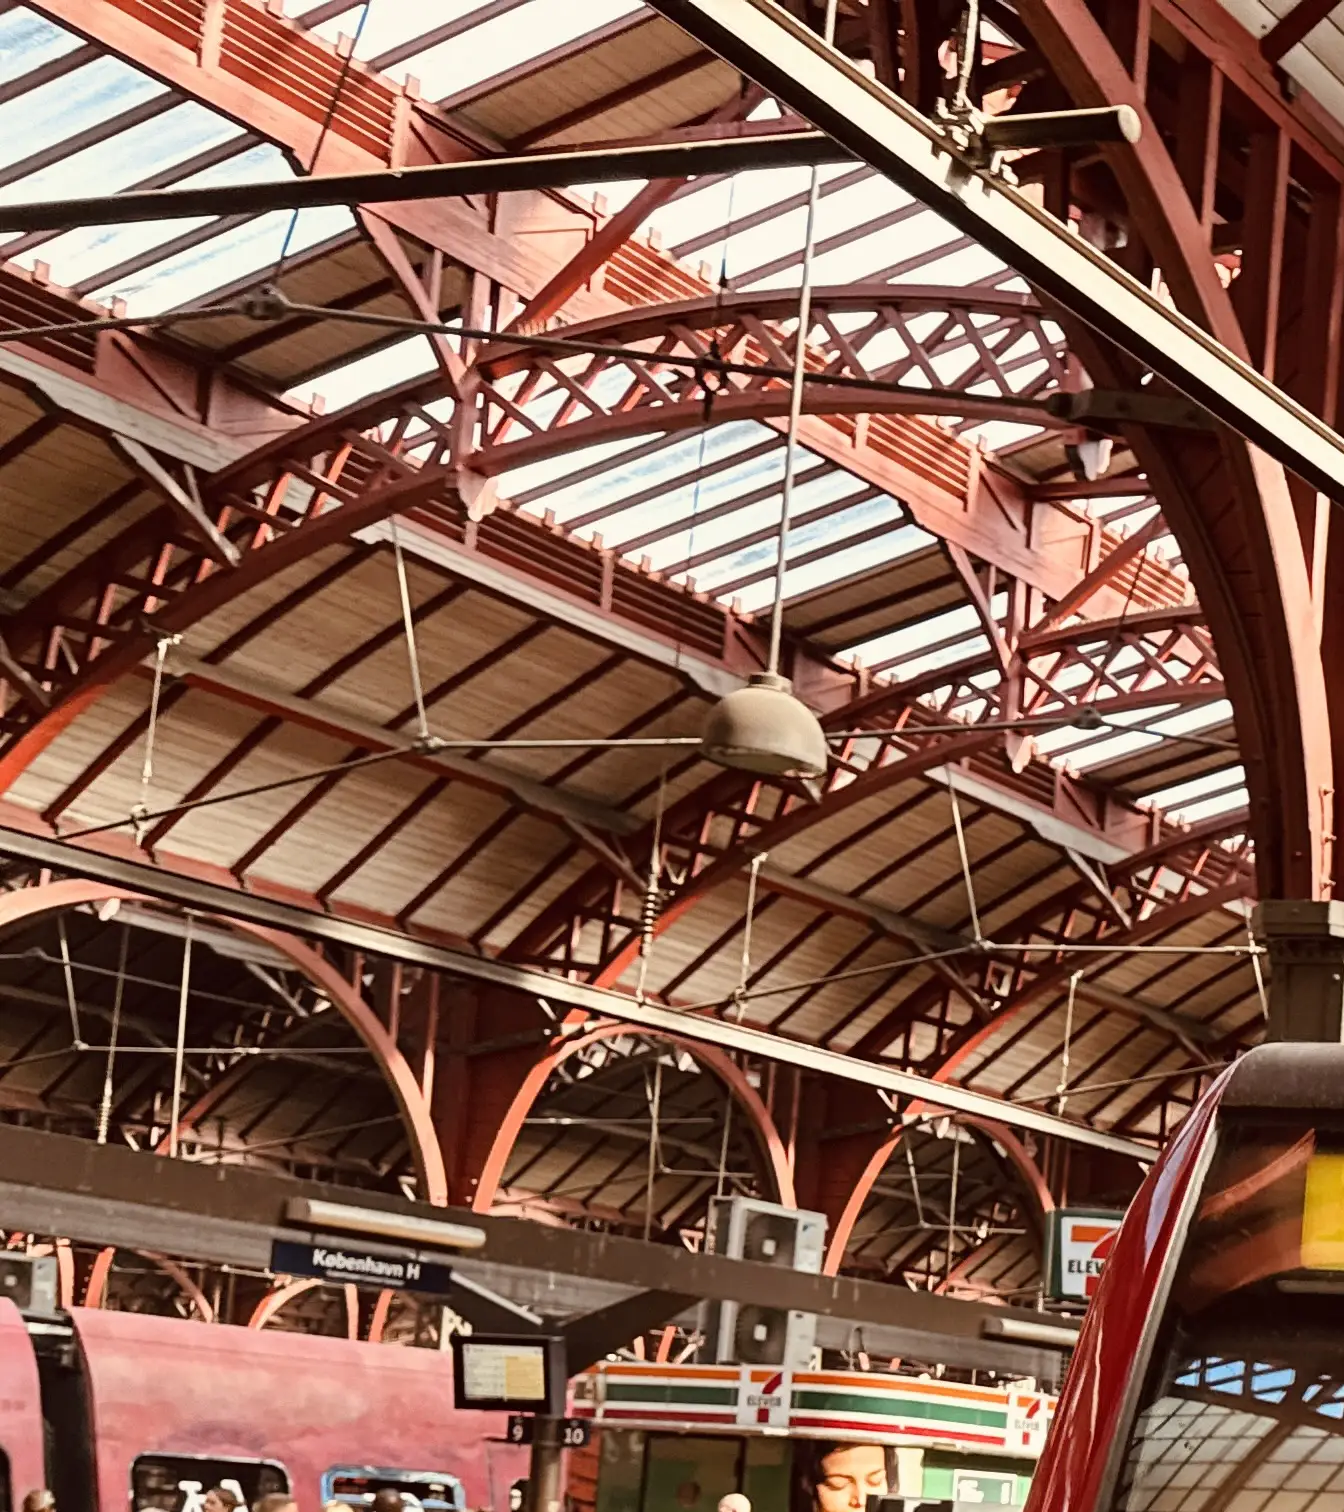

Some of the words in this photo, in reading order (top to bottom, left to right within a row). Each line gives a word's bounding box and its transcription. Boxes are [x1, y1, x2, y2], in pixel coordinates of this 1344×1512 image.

[312, 1248, 403, 1278] København
[406, 1263, 421, 1280] H
[512, 1424, 523, 1441] 9
[564, 1428, 584, 1444] 10
